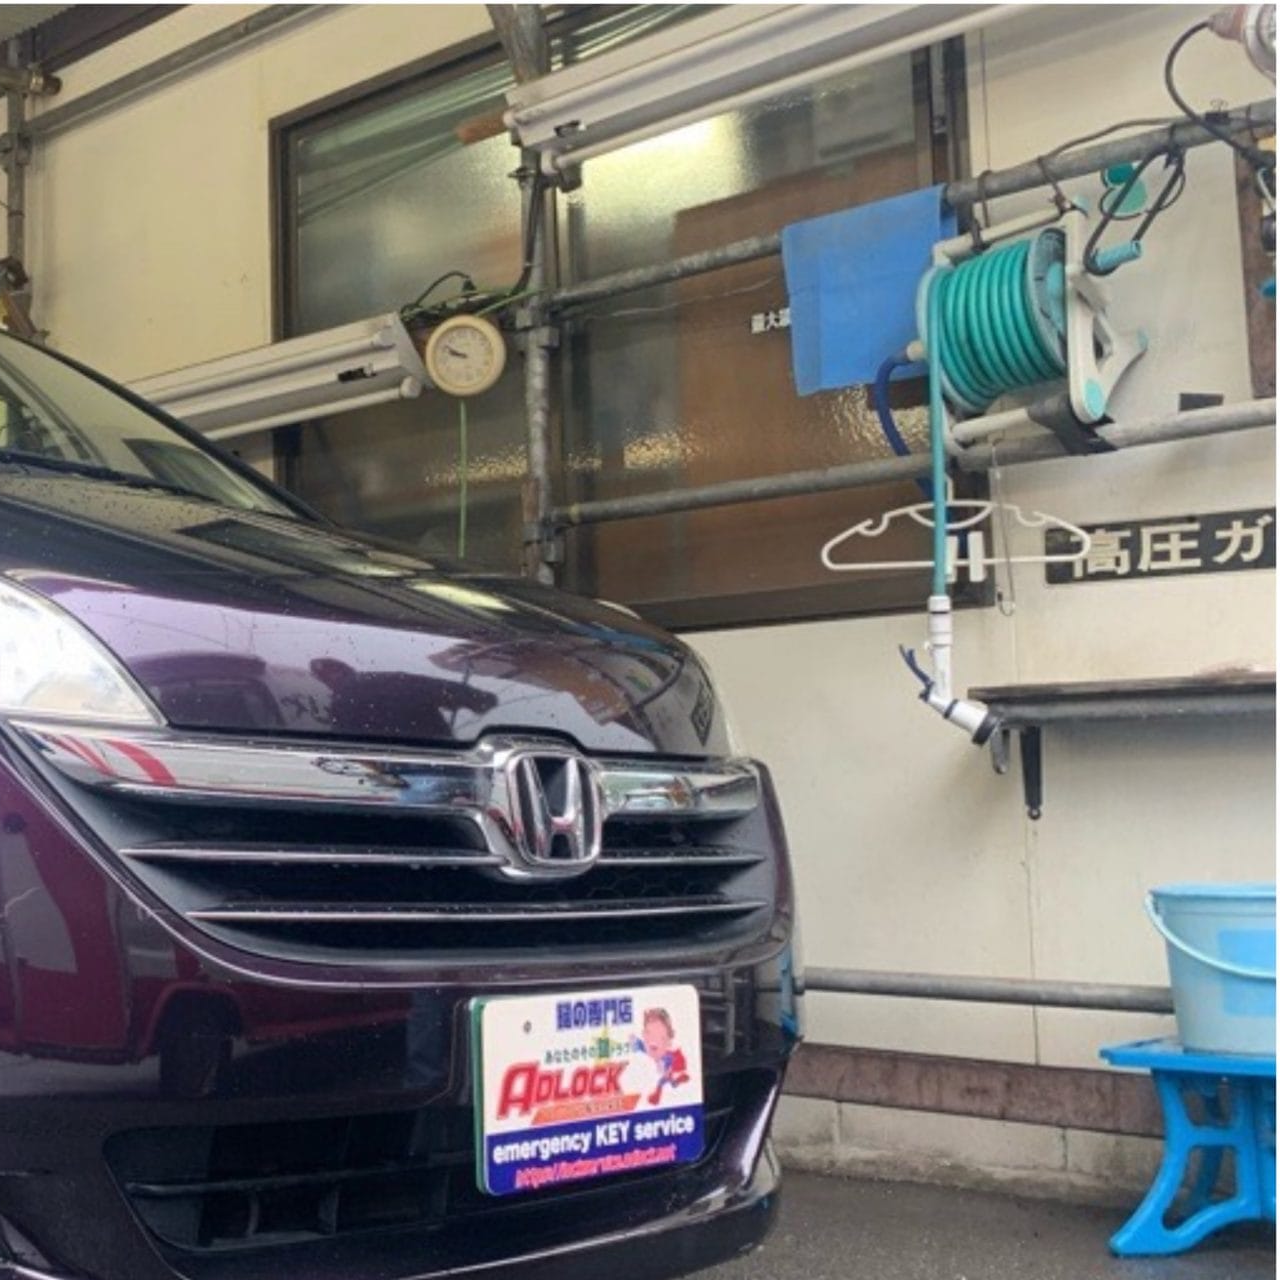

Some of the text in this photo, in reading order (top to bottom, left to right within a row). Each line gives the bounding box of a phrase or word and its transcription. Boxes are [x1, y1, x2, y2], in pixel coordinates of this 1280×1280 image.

[1070, 514, 1273, 579] 高圧ガ
[496, 1060, 629, 1120] ADLOCK
[493, 1114, 695, 1164] emergency KEY service
